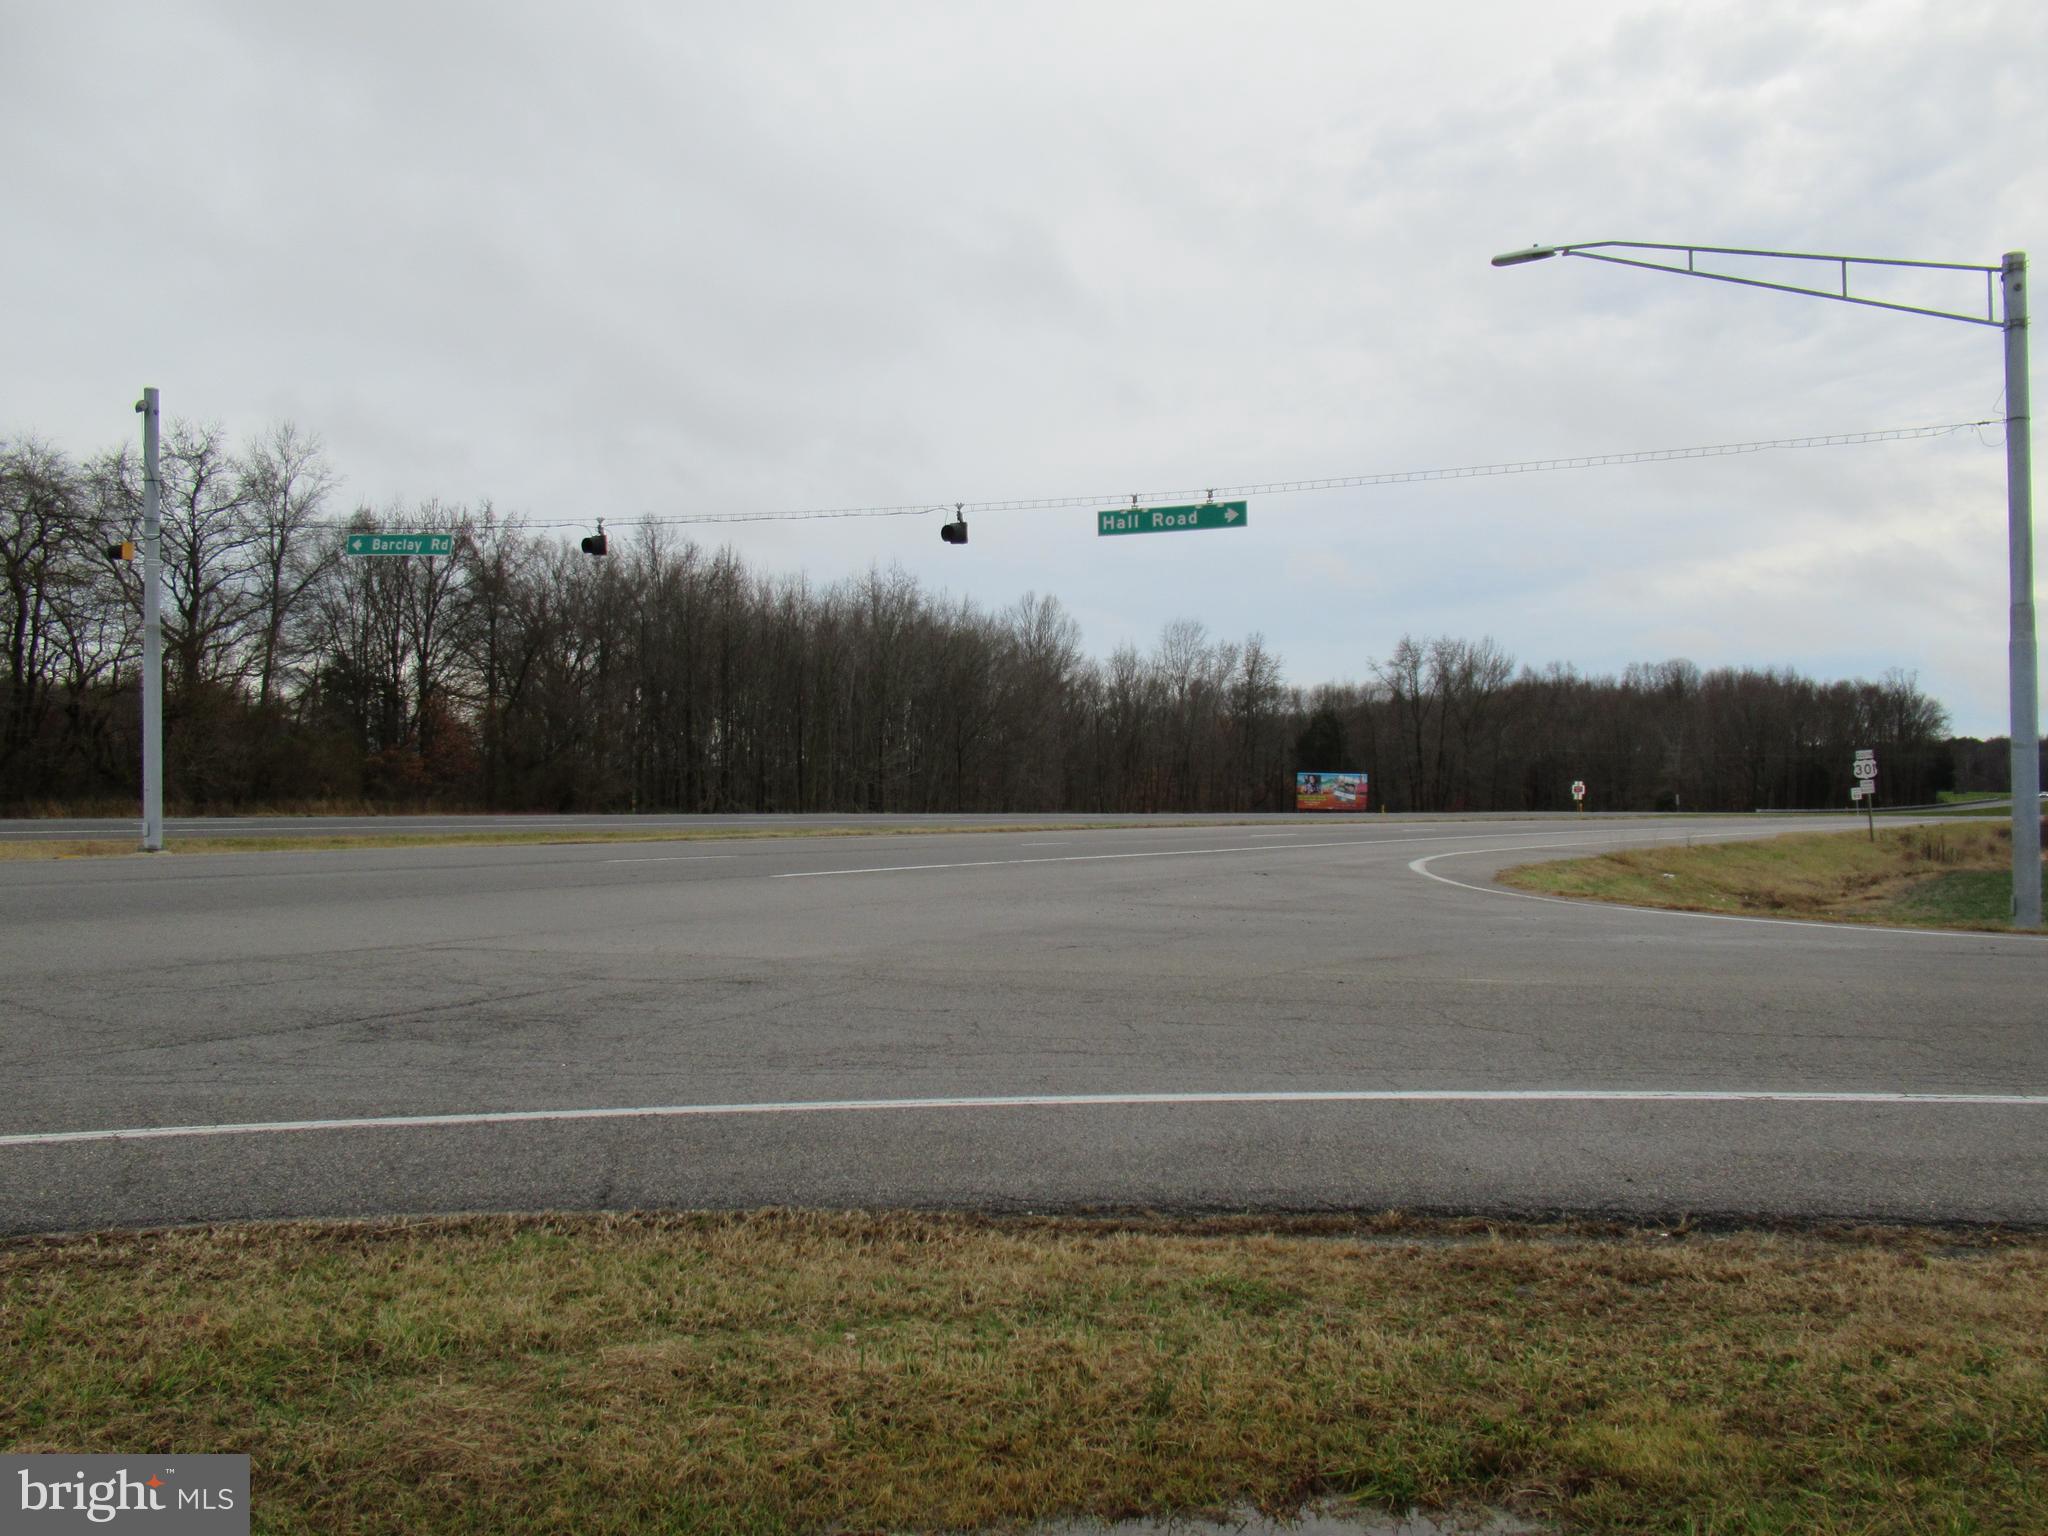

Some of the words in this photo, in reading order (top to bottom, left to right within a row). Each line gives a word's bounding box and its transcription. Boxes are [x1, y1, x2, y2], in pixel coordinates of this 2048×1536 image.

[1103, 514, 1139, 530] Hall
[1152, 510, 1198, 527] Road
[372, 538, 422, 553] Barclay
[431, 538, 449, 550] Rd
[1855, 764, 1876, 775] 301
